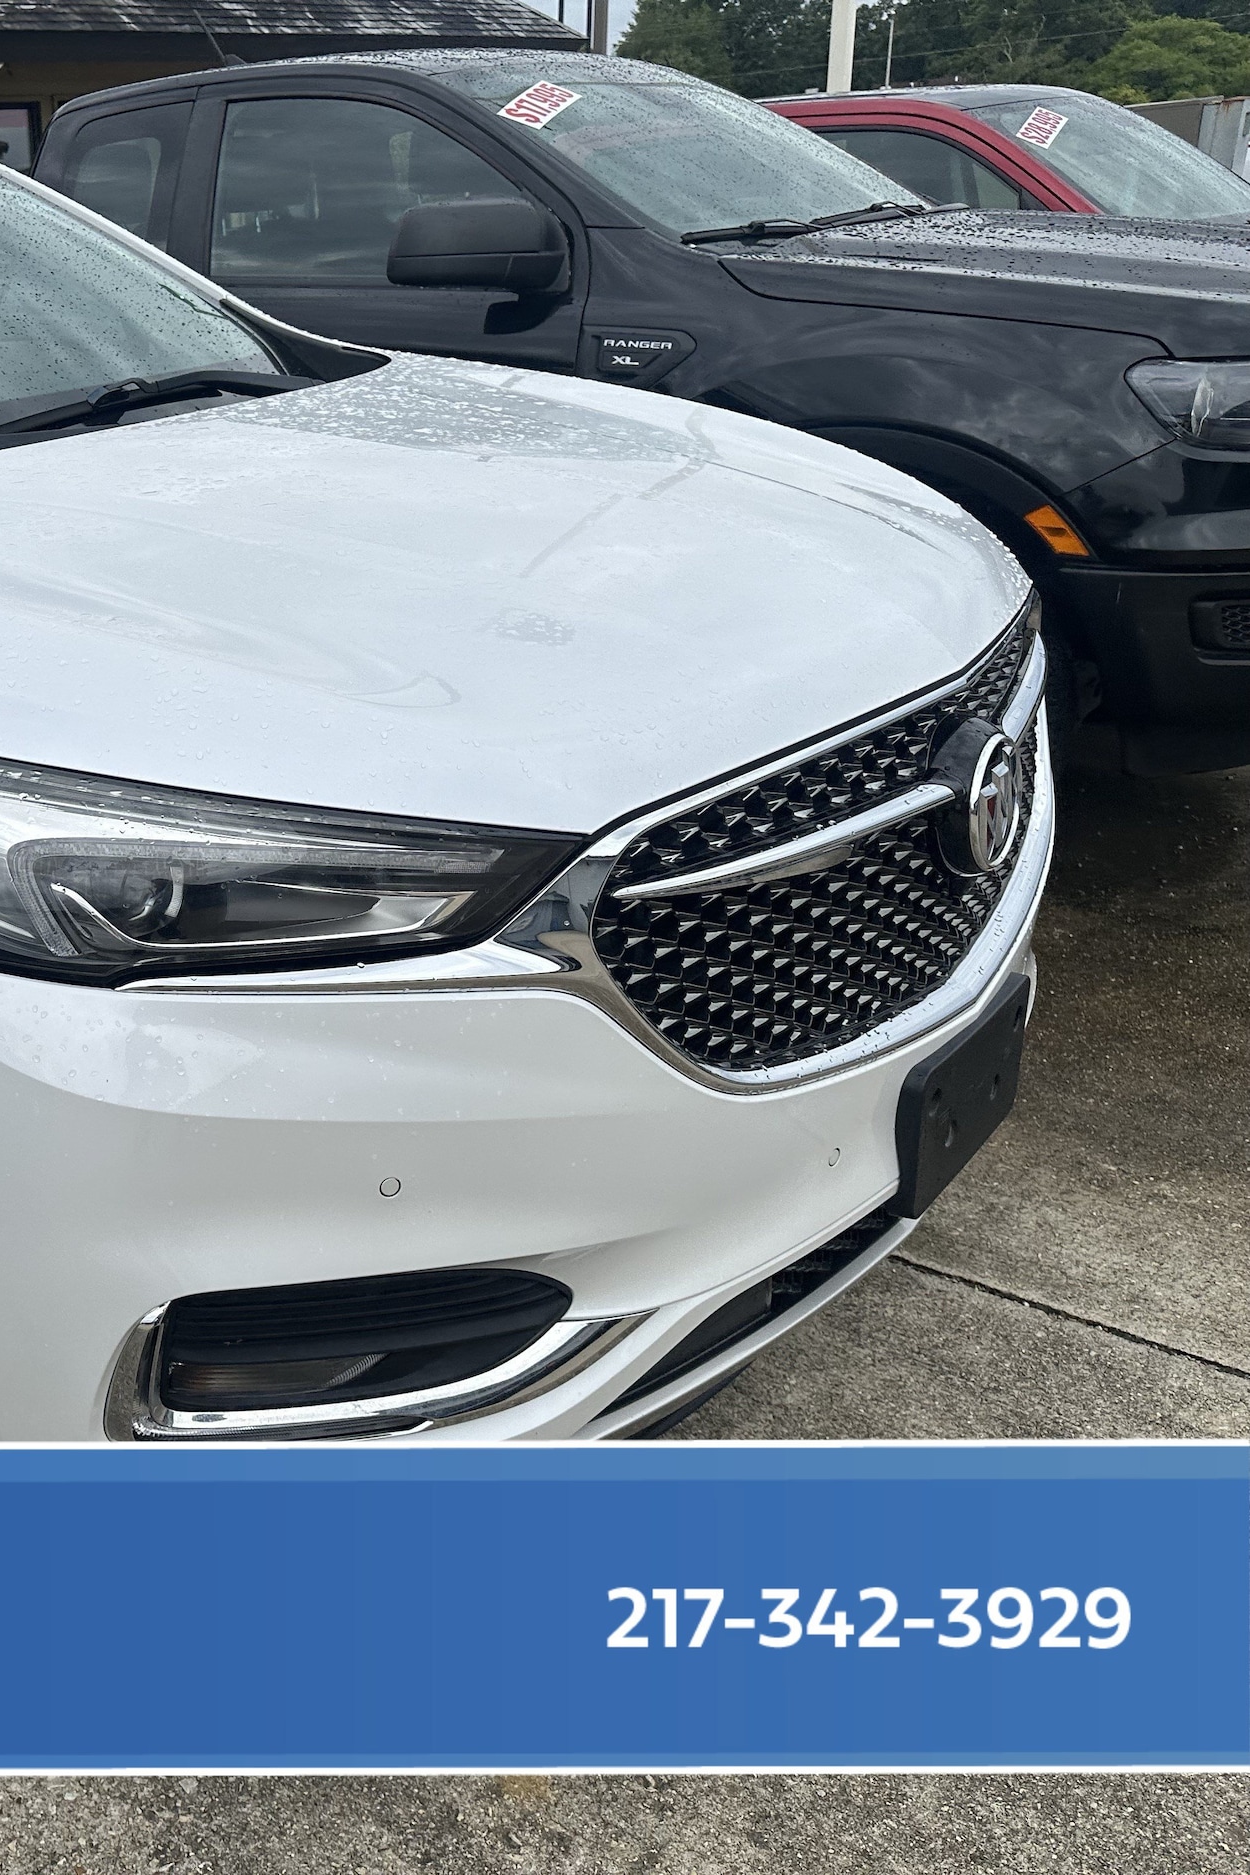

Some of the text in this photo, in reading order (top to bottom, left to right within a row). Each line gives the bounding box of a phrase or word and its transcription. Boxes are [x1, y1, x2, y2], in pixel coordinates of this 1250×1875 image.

[504, 83, 575, 124] $17,995
[603, 339, 673, 350] RANGER
[611, 355, 640, 366] XL
